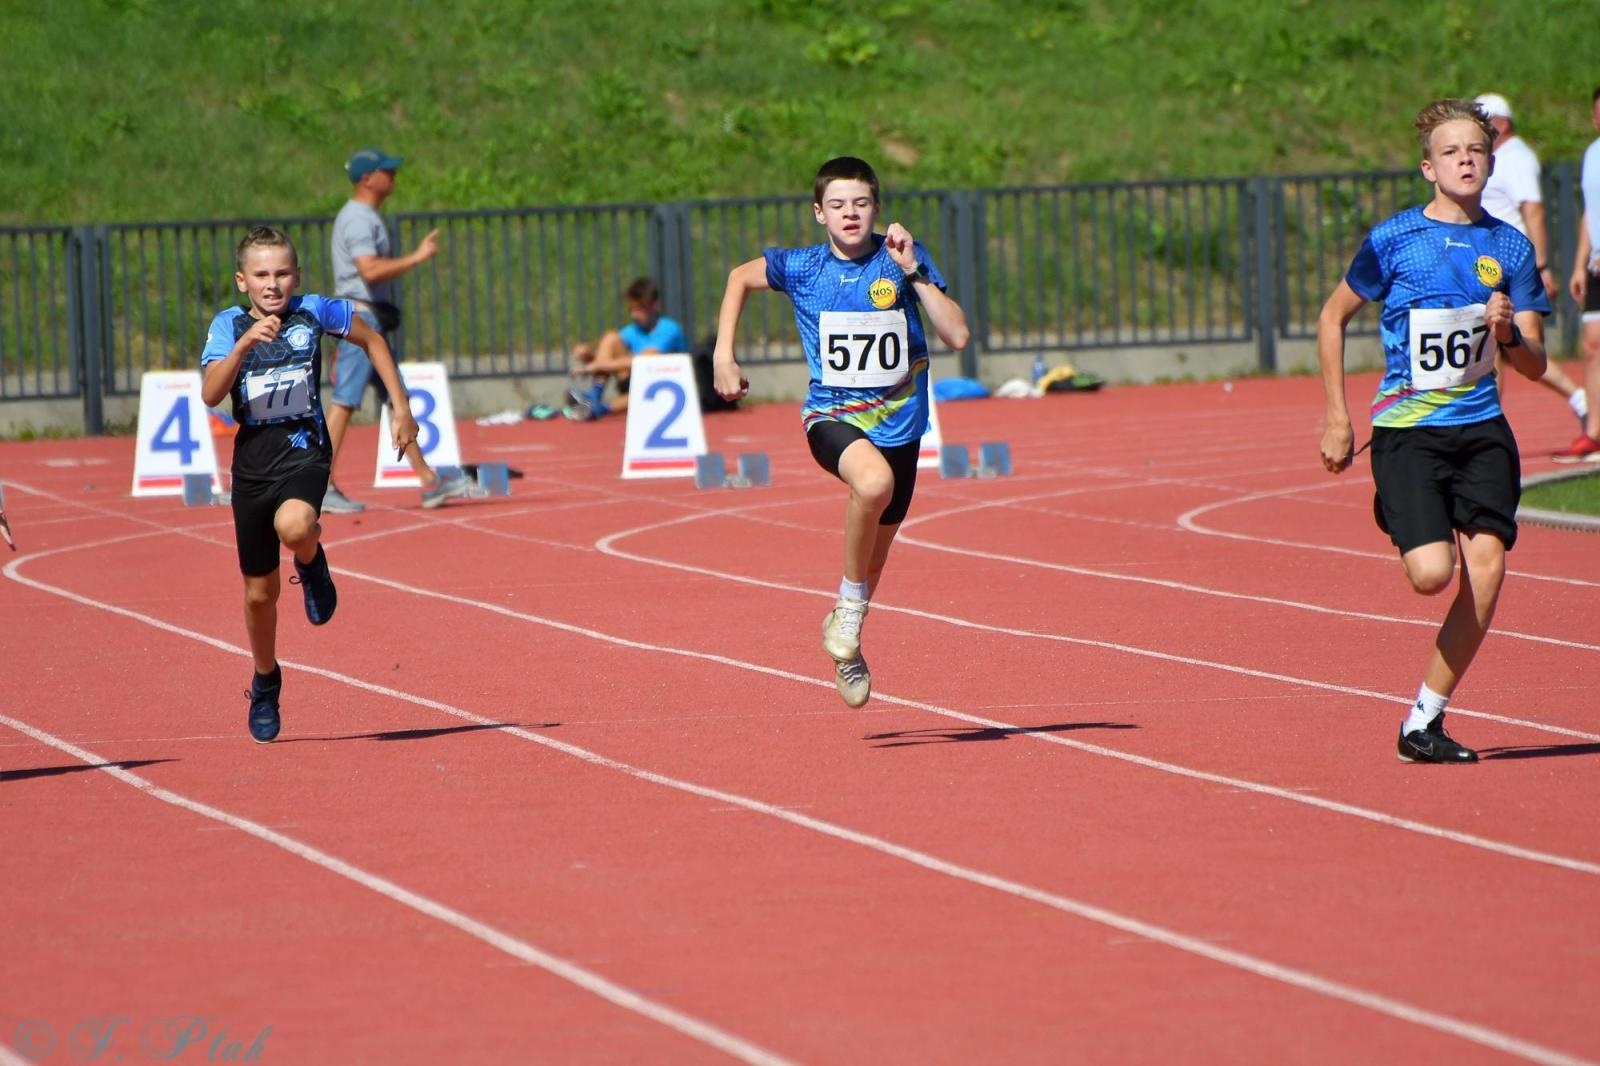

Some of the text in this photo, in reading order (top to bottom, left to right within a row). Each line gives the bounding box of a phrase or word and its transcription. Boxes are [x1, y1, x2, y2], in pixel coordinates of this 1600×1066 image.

[828, 332, 901, 372] 570
[1419, 324, 1491, 372] 567
[264, 379, 296, 409] 77
[643, 380, 689, 449] 2
[150, 396, 200, 466] 4
